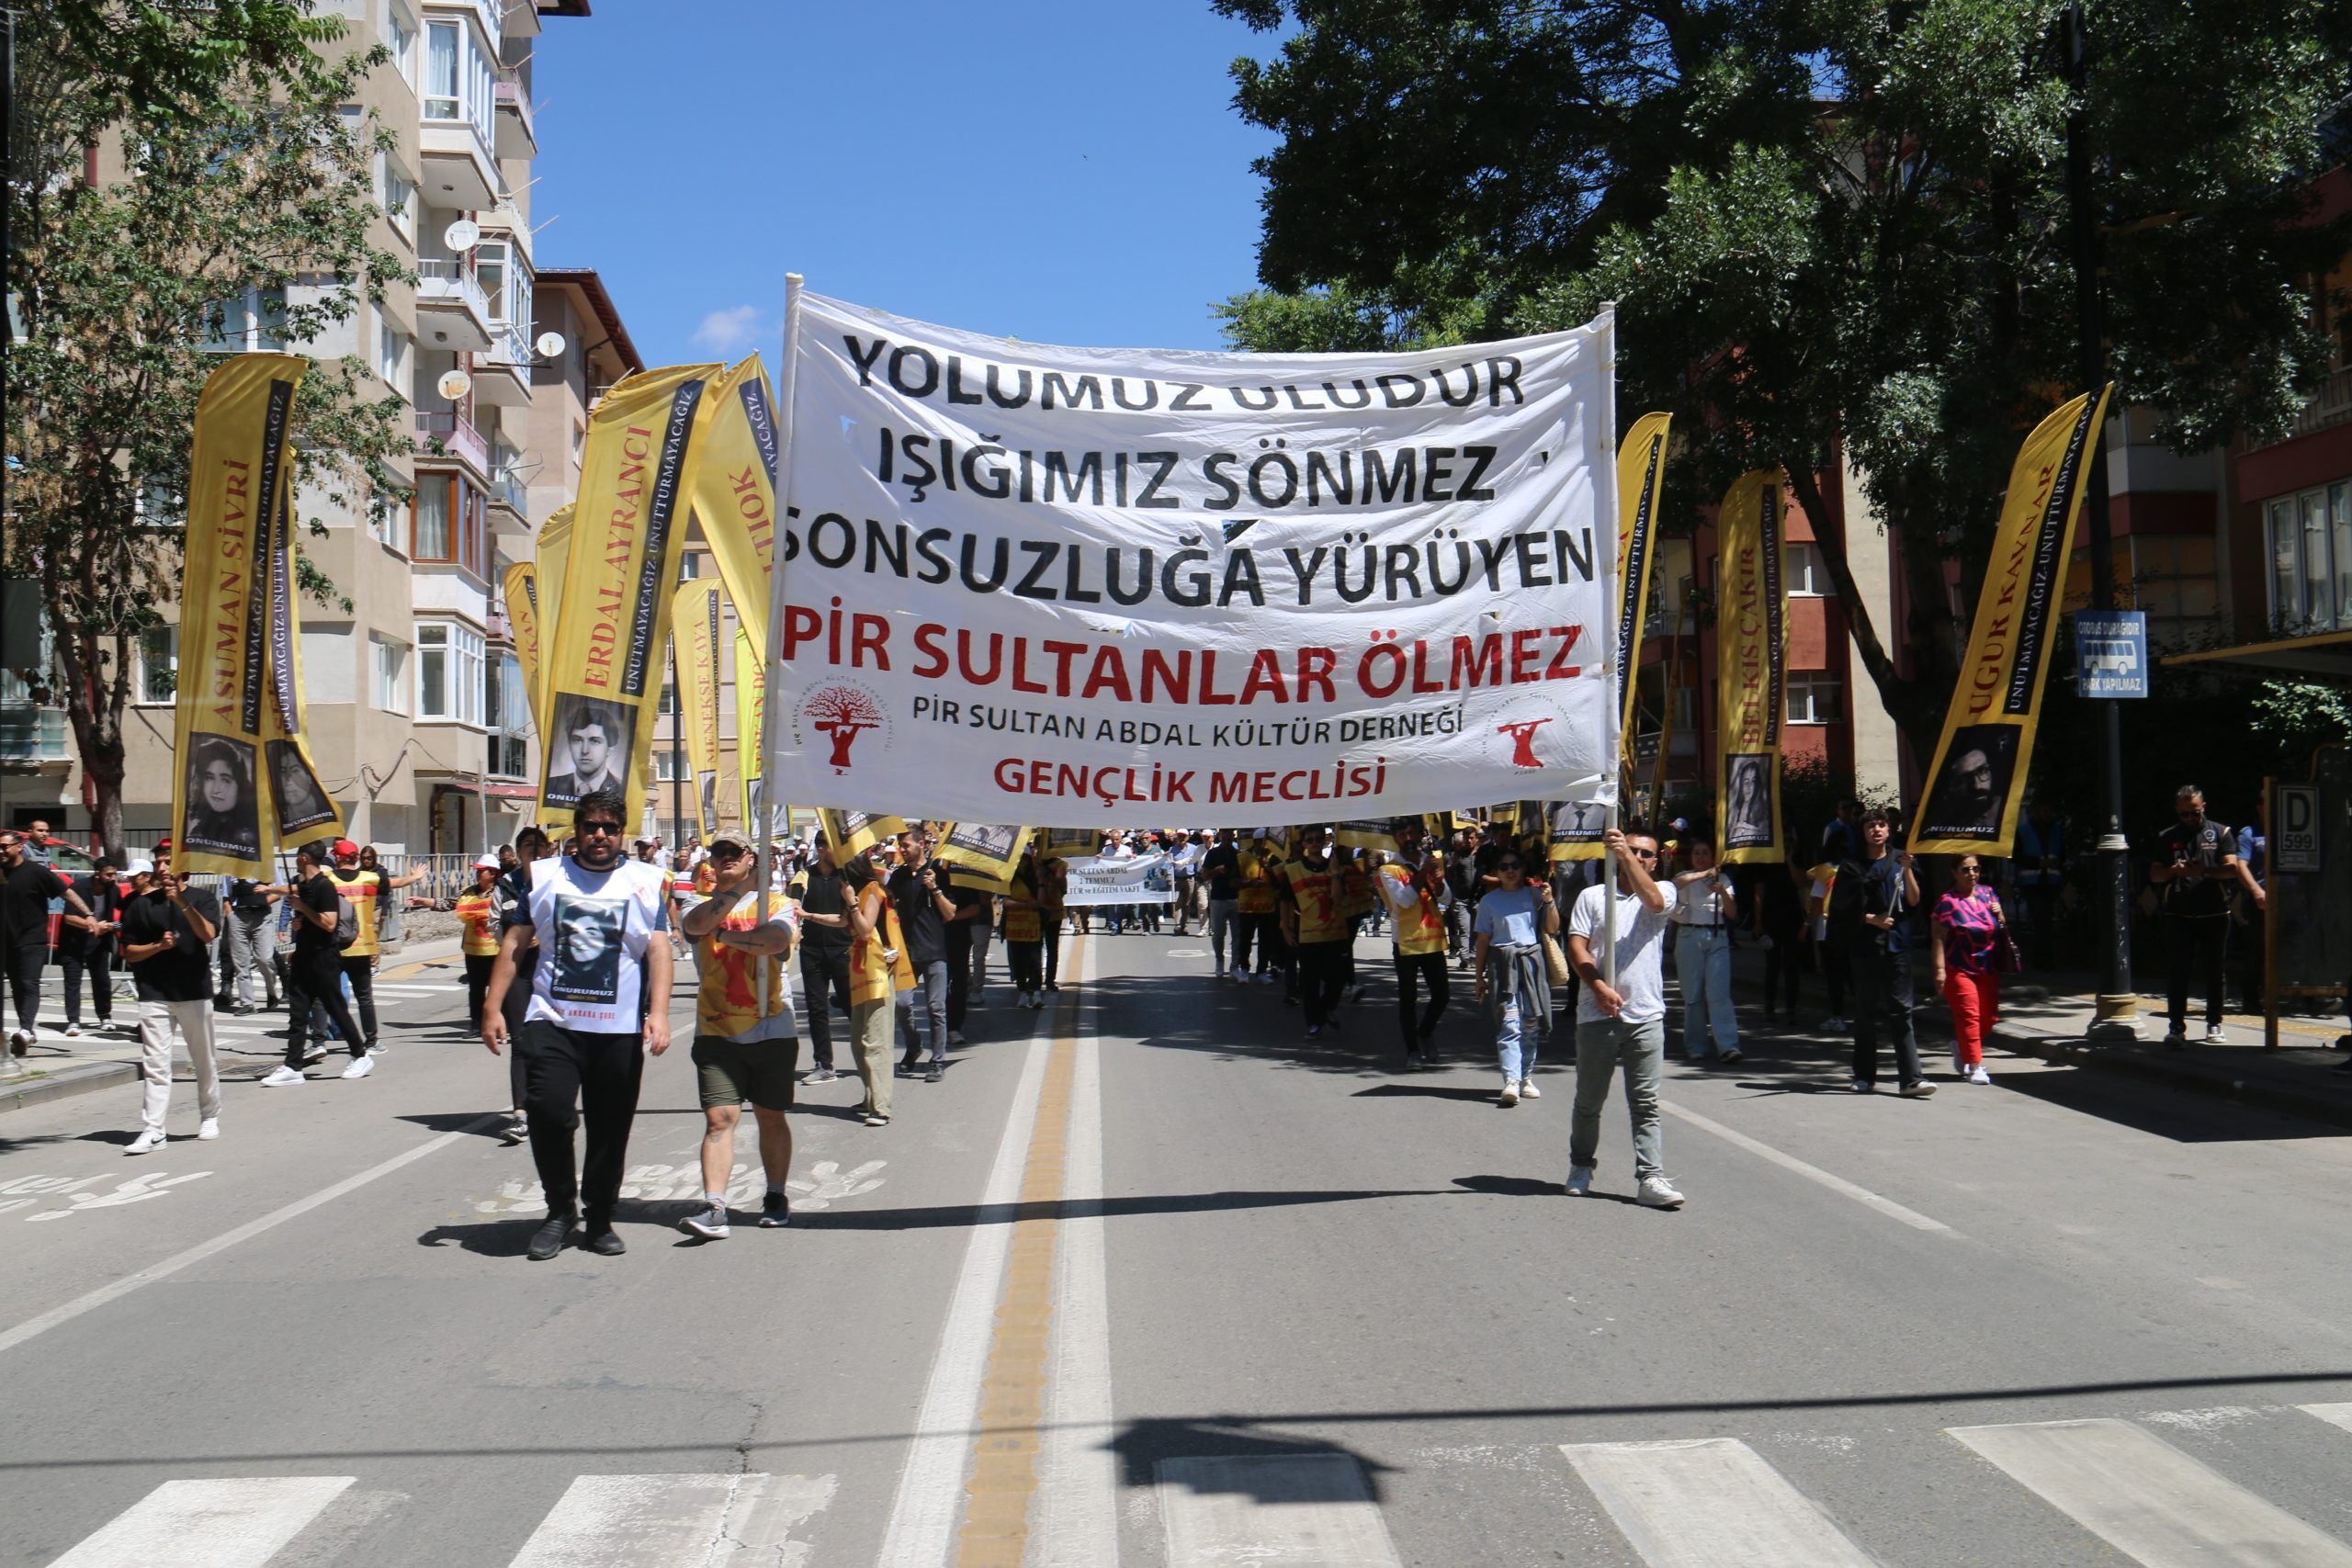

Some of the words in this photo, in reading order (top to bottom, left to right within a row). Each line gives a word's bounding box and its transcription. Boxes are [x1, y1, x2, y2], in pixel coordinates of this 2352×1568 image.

[842, 335, 1213, 412] YOLUMUZ
[1228, 355, 1524, 410] ULUDUR
[604, 426, 651, 575] AYRANCI
[879, 427, 1180, 509] IŞIĞIMIZ
[1203, 437, 1498, 510] SÖNMEZ
[217, 459, 250, 560] SİVRİ
[1997, 462, 2056, 606] KAYNAR
[785, 507, 1266, 607] SONSUZLUĞA
[1283, 527, 1594, 606] YÜRÜYEN
[1739, 548, 1762, 637] ÇAKIR
[213, 570, 243, 727] ASUMAN
[584, 581, 626, 688] ERDAL
[694, 620, 709, 669] KAYA
[782, 596, 891, 671] PİR
[912, 623, 1337, 705] SULTANLAR
[1357, 625, 1583, 698] ÖLMEZ
[913, 694, 959, 724] PİR
[969, 704, 1084, 739] SULTAN
[1096, 718, 1202, 747] ABDAL
[1213, 716, 1329, 747] KÜLTÜR
[1340, 704, 1463, 742] DERNEĞİ
[1741, 645, 1760, 745] BELKIS
[2083, 677, 2101, 691] PARK
[2102, 677, 2142, 691] YAPILMAZ
[994, 759, 1196, 808] GENÇLİK
[1209, 757, 1386, 803] MECLİSİ
[2287, 792, 2311, 832] D
[186, 837, 256, 853] ONURUMUZ
[2285, 834, 2312, 849] 599
[1069, 886, 1084, 895] TÜR
[1085, 876, 1116, 885] TEMMUZ
[553, 986, 615, 997] ONURUMUZ
